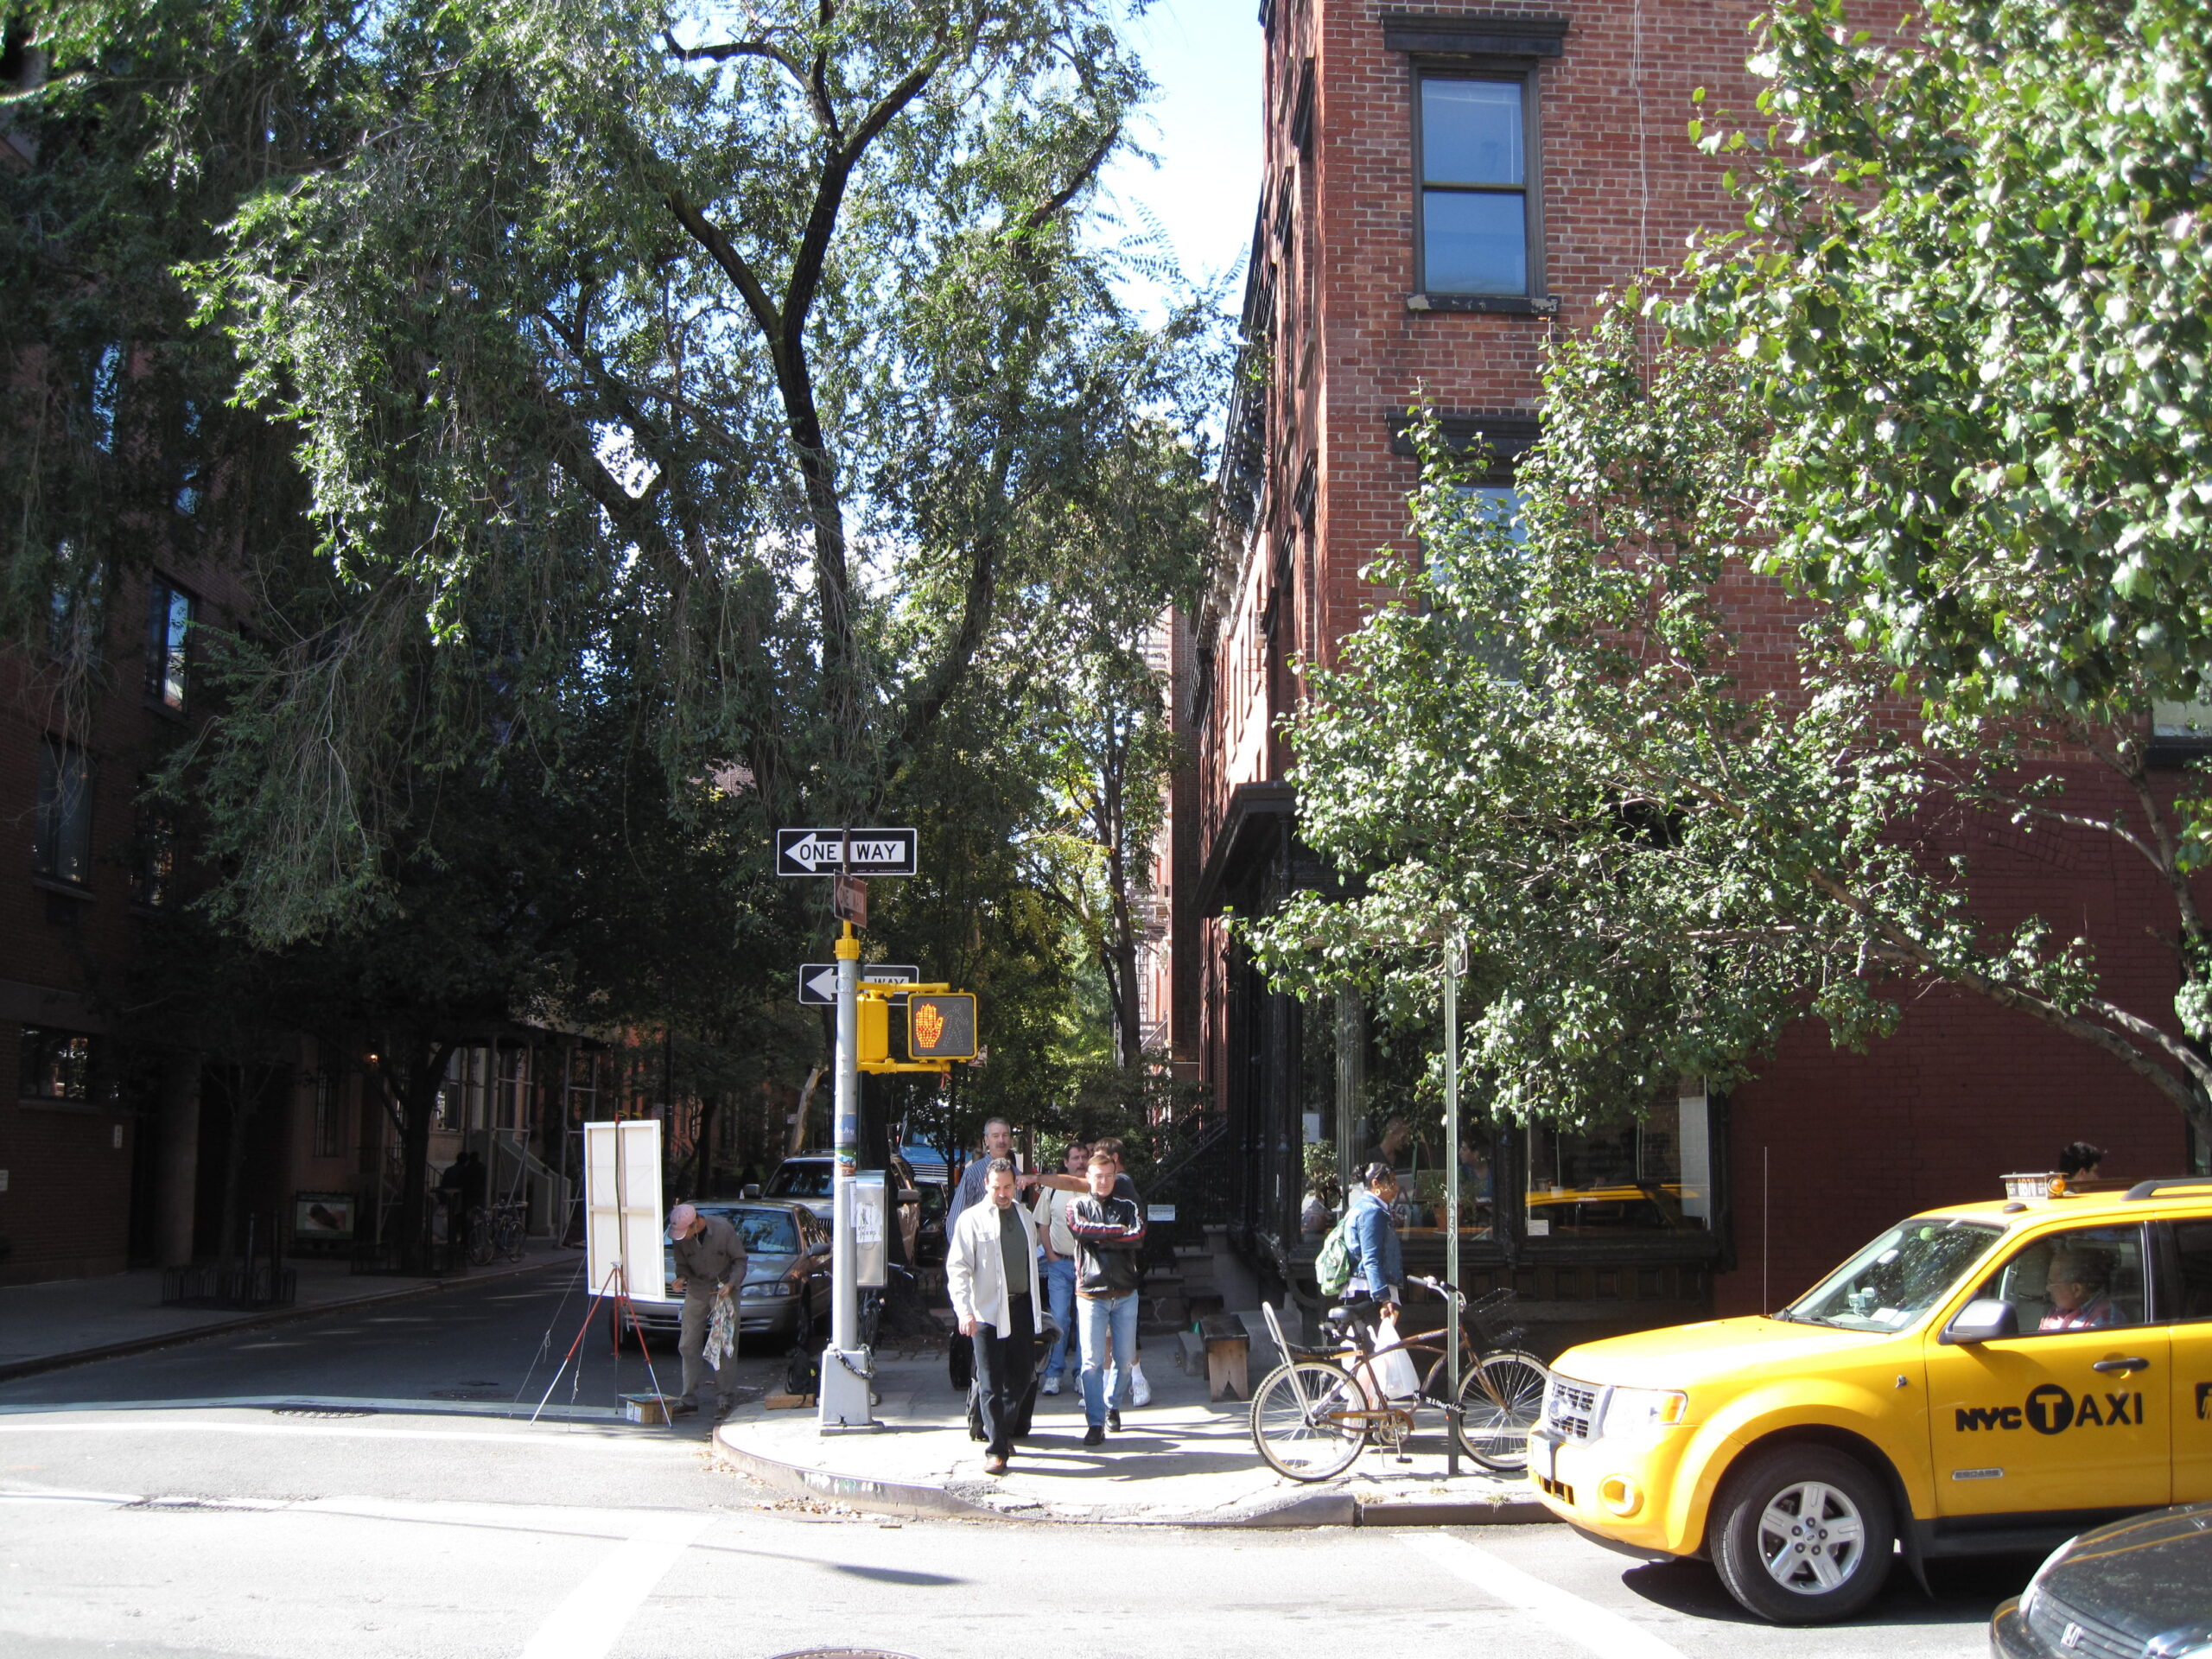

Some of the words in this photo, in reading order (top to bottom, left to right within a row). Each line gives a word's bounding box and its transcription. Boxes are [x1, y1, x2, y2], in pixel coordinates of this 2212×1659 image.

[799, 843, 837, 861] ONE
[856, 843, 897, 861] WAY
[1955, 1407, 2022, 1432] NYC
[2032, 1390, 2143, 1431] TAXI
